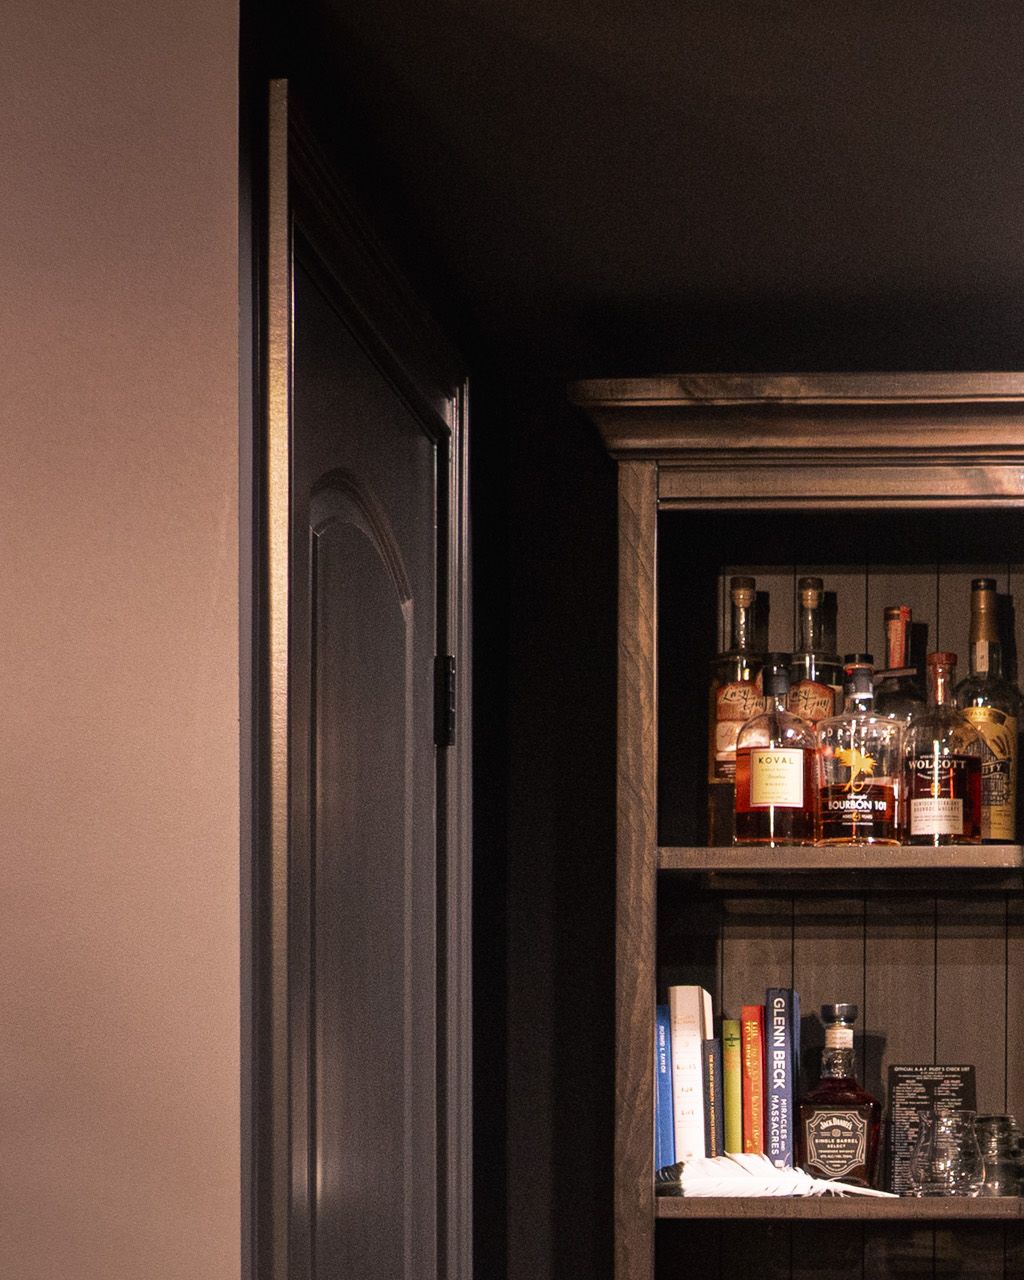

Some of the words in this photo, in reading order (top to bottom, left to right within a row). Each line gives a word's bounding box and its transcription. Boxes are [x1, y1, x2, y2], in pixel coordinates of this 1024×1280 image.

[758, 757, 794, 766] KOVAL
[908, 759, 966, 770] WOLCOTT
[828, 800, 872, 810] BOURBON
[874, 801, 887, 811] 101
[773, 998, 786, 1047] GLENN
[773, 1050, 786, 1089] BECK
[771, 1095, 780, 1155] MASSACRES
[780, 1098, 788, 1140] MIRACLES
